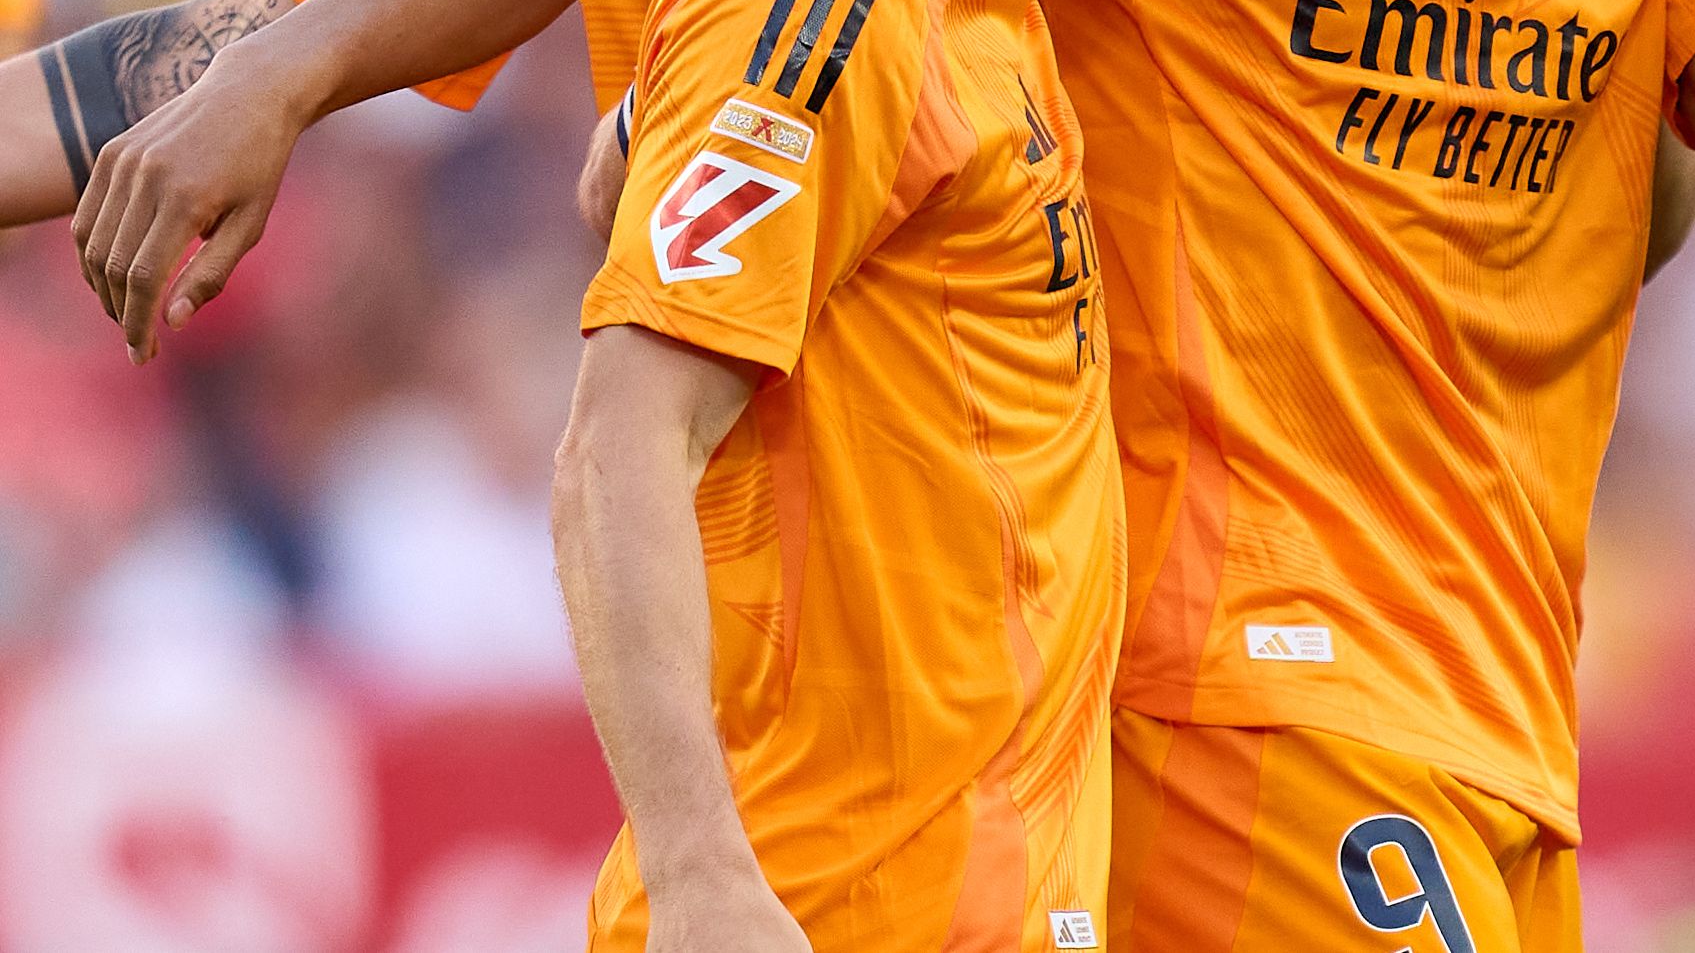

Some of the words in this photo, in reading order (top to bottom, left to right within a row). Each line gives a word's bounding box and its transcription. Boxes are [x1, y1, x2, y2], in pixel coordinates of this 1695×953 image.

[723, 109, 752, 129] 2023
[1335, 87, 1436, 171] FLY
[1432, 104, 1576, 195] BETTER
[1337, 813, 1478, 953] 9
